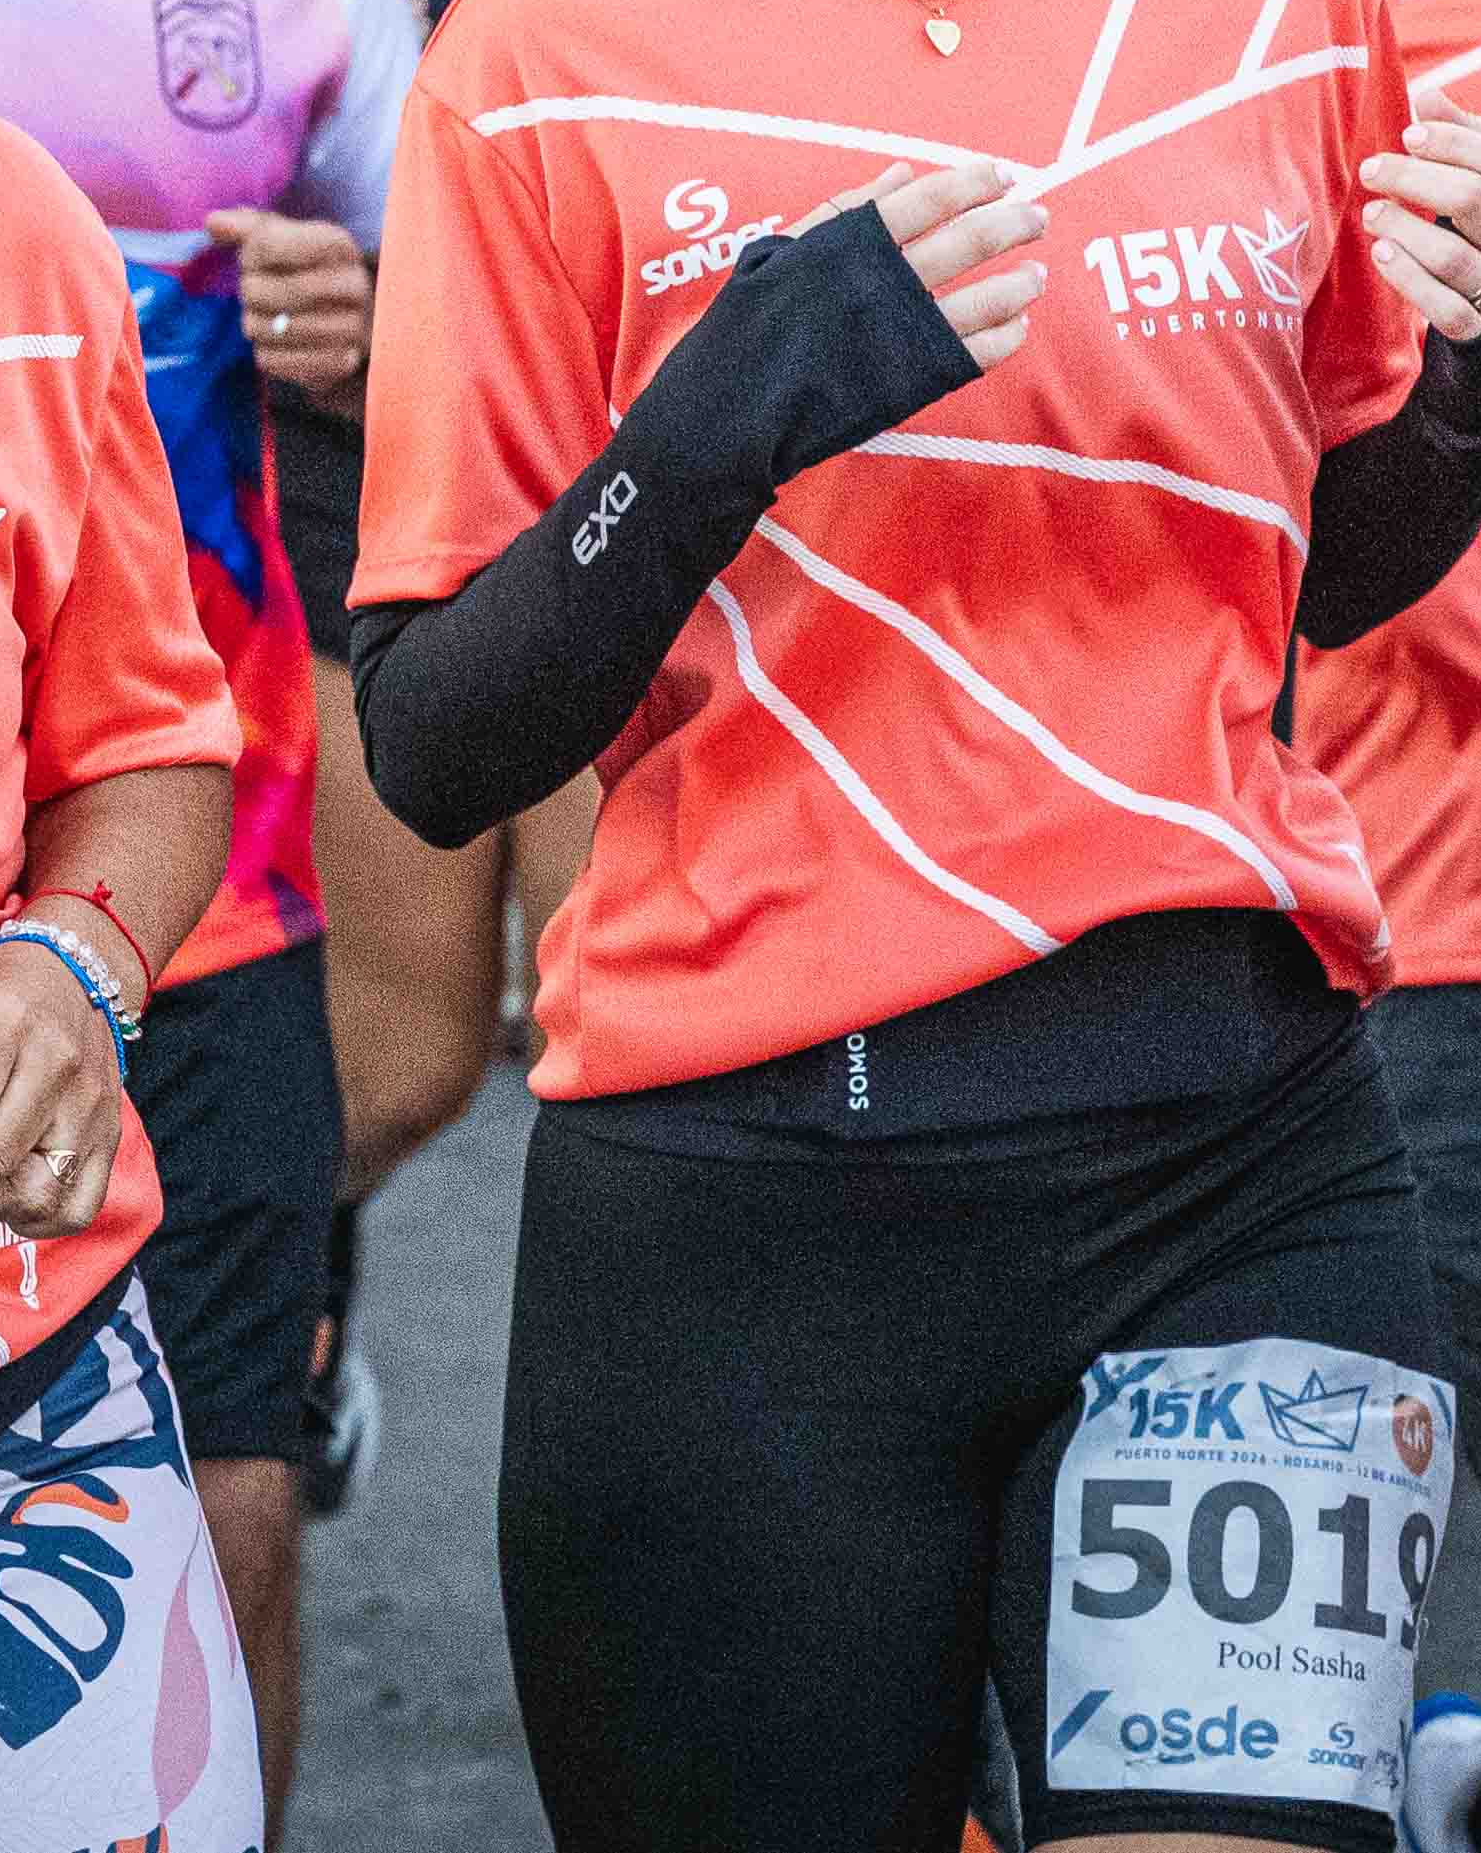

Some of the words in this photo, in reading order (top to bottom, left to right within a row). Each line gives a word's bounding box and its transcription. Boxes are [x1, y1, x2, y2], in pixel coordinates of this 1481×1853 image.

[1084, 224, 1243, 312] 15K
[1116, 309, 1245, 340] PUERTO
[572, 471, 638, 565] EXO
[1127, 1382, 1245, 1441] 15K
[1218, 1642, 1281, 1673] Pool
[1292, 1647, 1367, 1683] Sasha
[1119, 1705, 1279, 1759] osde
